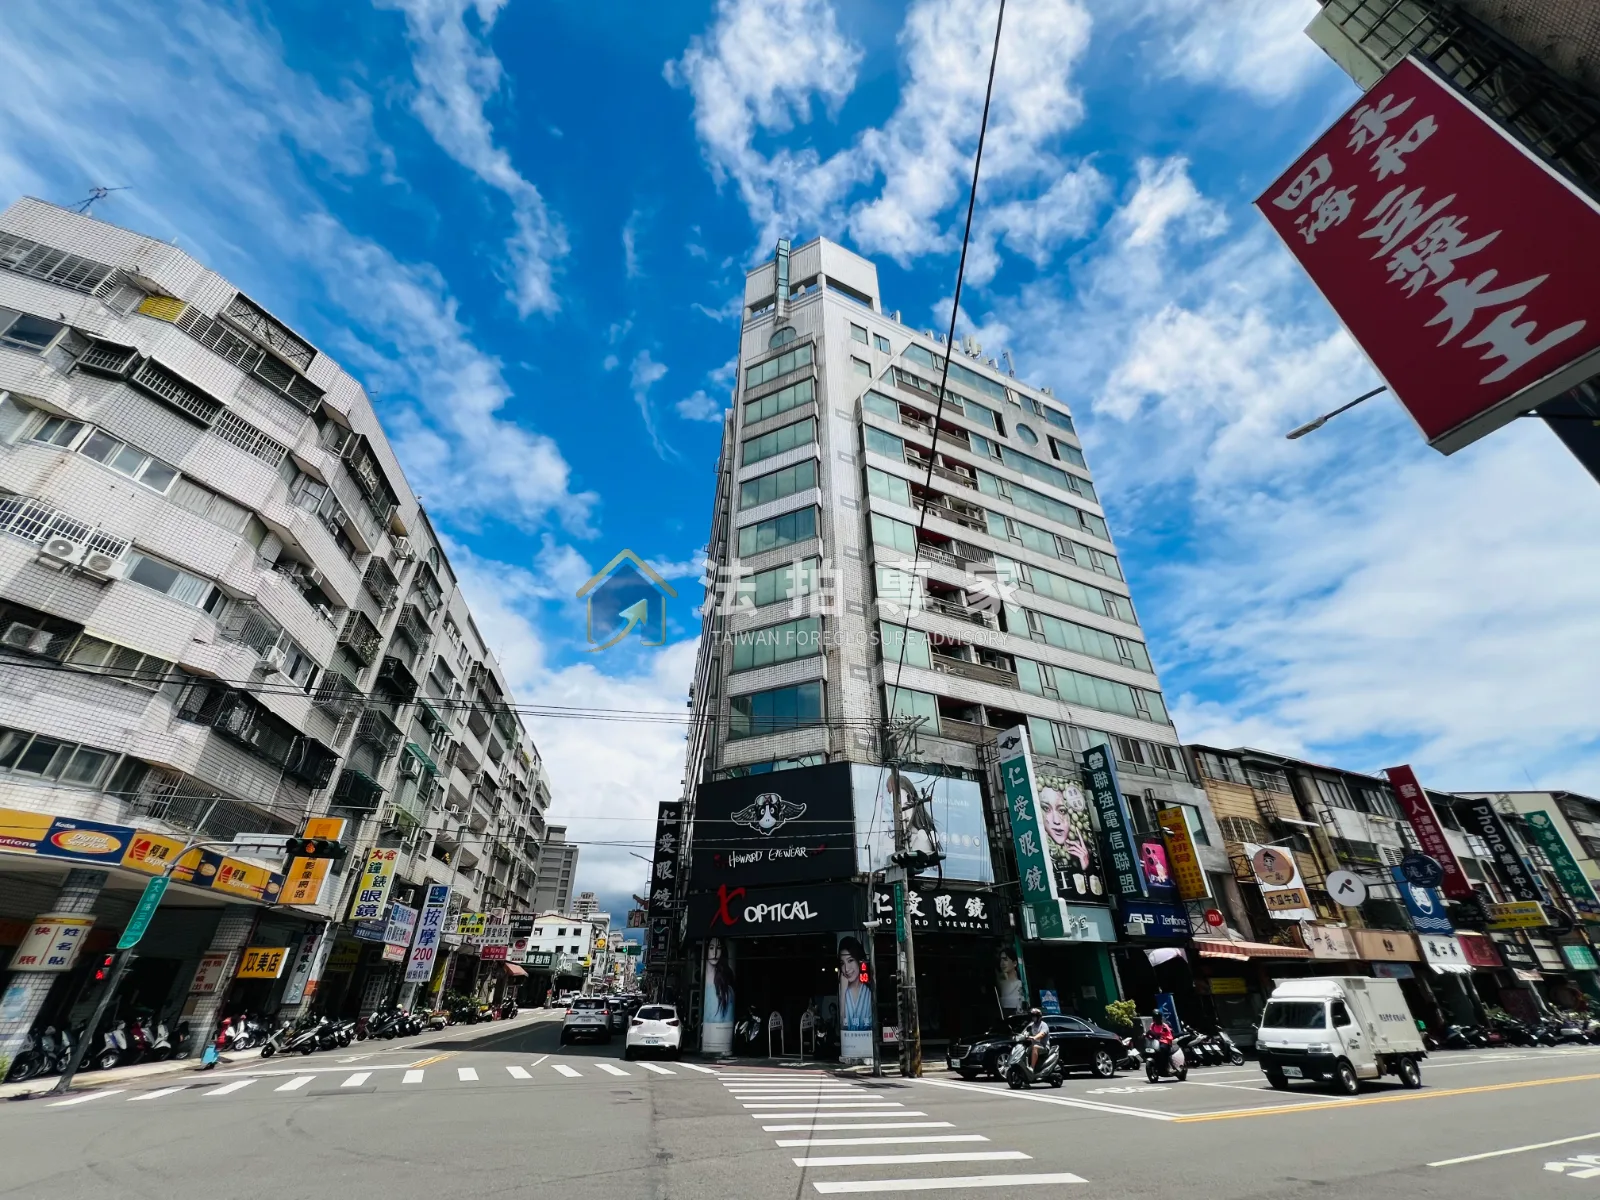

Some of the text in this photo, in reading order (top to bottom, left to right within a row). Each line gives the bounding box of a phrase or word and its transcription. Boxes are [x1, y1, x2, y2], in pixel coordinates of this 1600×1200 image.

[1346, 93, 1438, 182] 永和
[1272, 152, 1358, 244] 四海
[1358, 184, 1587, 386] 豆漿大王
[55, 821, 76, 829] Kodak
[1008, 766, 1046, 892] 仁愛眼鏡
[1092, 771, 1137, 894] 聯強電信聯盟
[370, 849, 398, 861] 大倉
[653, 808, 677, 909] 仁愛眼鏡
[744, 900, 819, 923] OPTICAL
[872, 890, 988, 920] 仁愛眼鏡
[1128, 912, 1187, 926] ASUS Zenfone
[418, 908, 442, 946] 按摩
[876, 917, 990, 929] HORD EYEWEAR
[47, 927, 80, 965] 姓名貼
[243, 952, 281, 973] 双美店
[413, 947, 433, 961] 200
